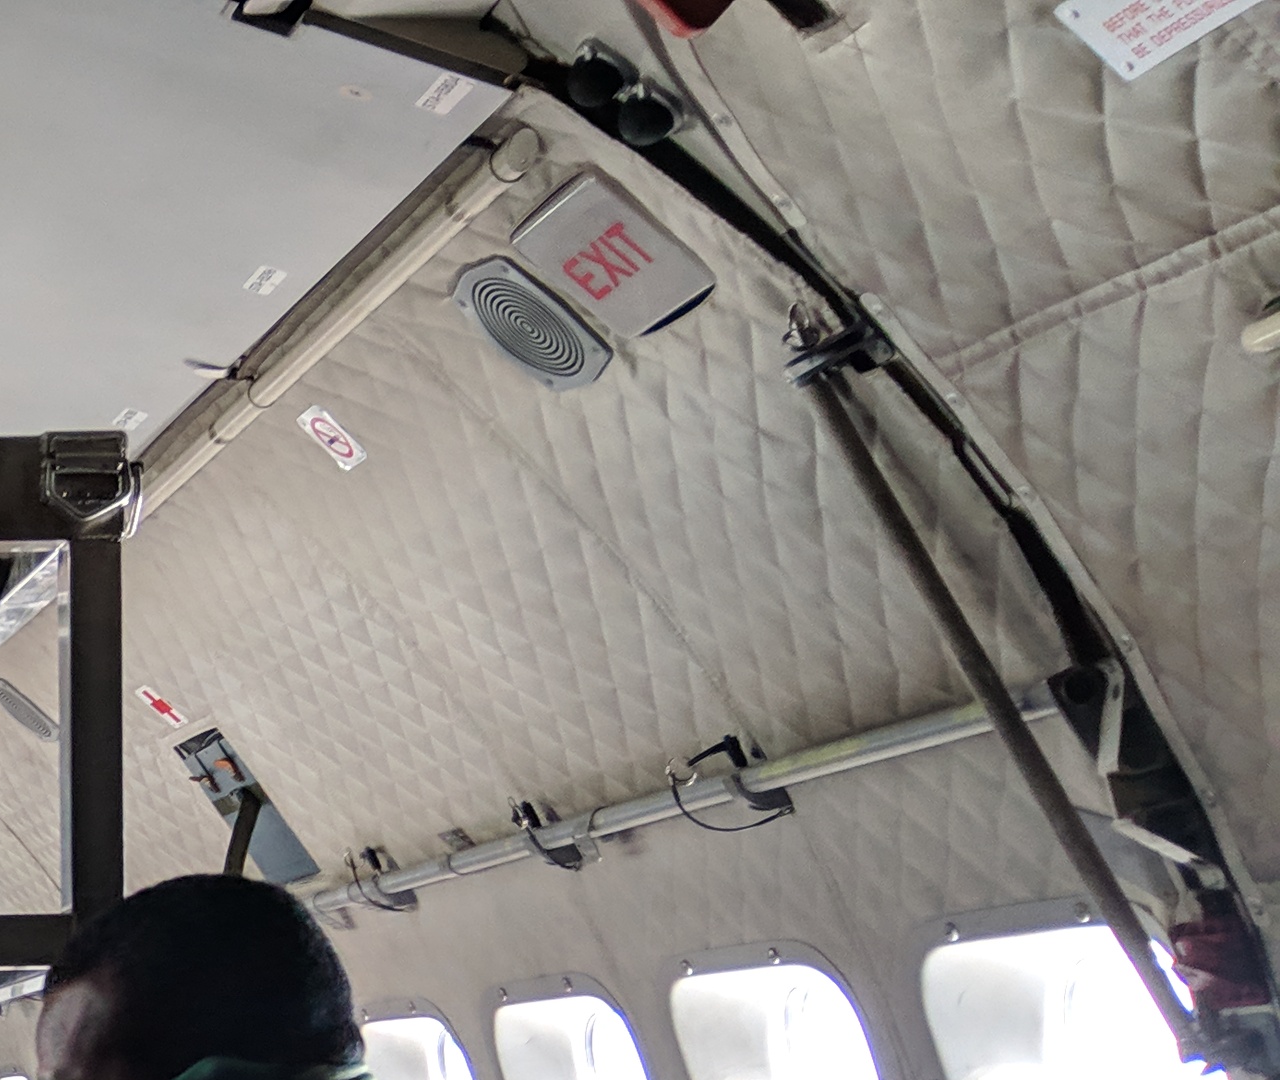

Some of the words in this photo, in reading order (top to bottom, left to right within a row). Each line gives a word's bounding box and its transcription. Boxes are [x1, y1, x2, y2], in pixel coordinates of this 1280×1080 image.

[1117, 22, 1147, 45] THAT
[1131, 42, 1152, 58] BE
[563, 222, 654, 300] EXIT
